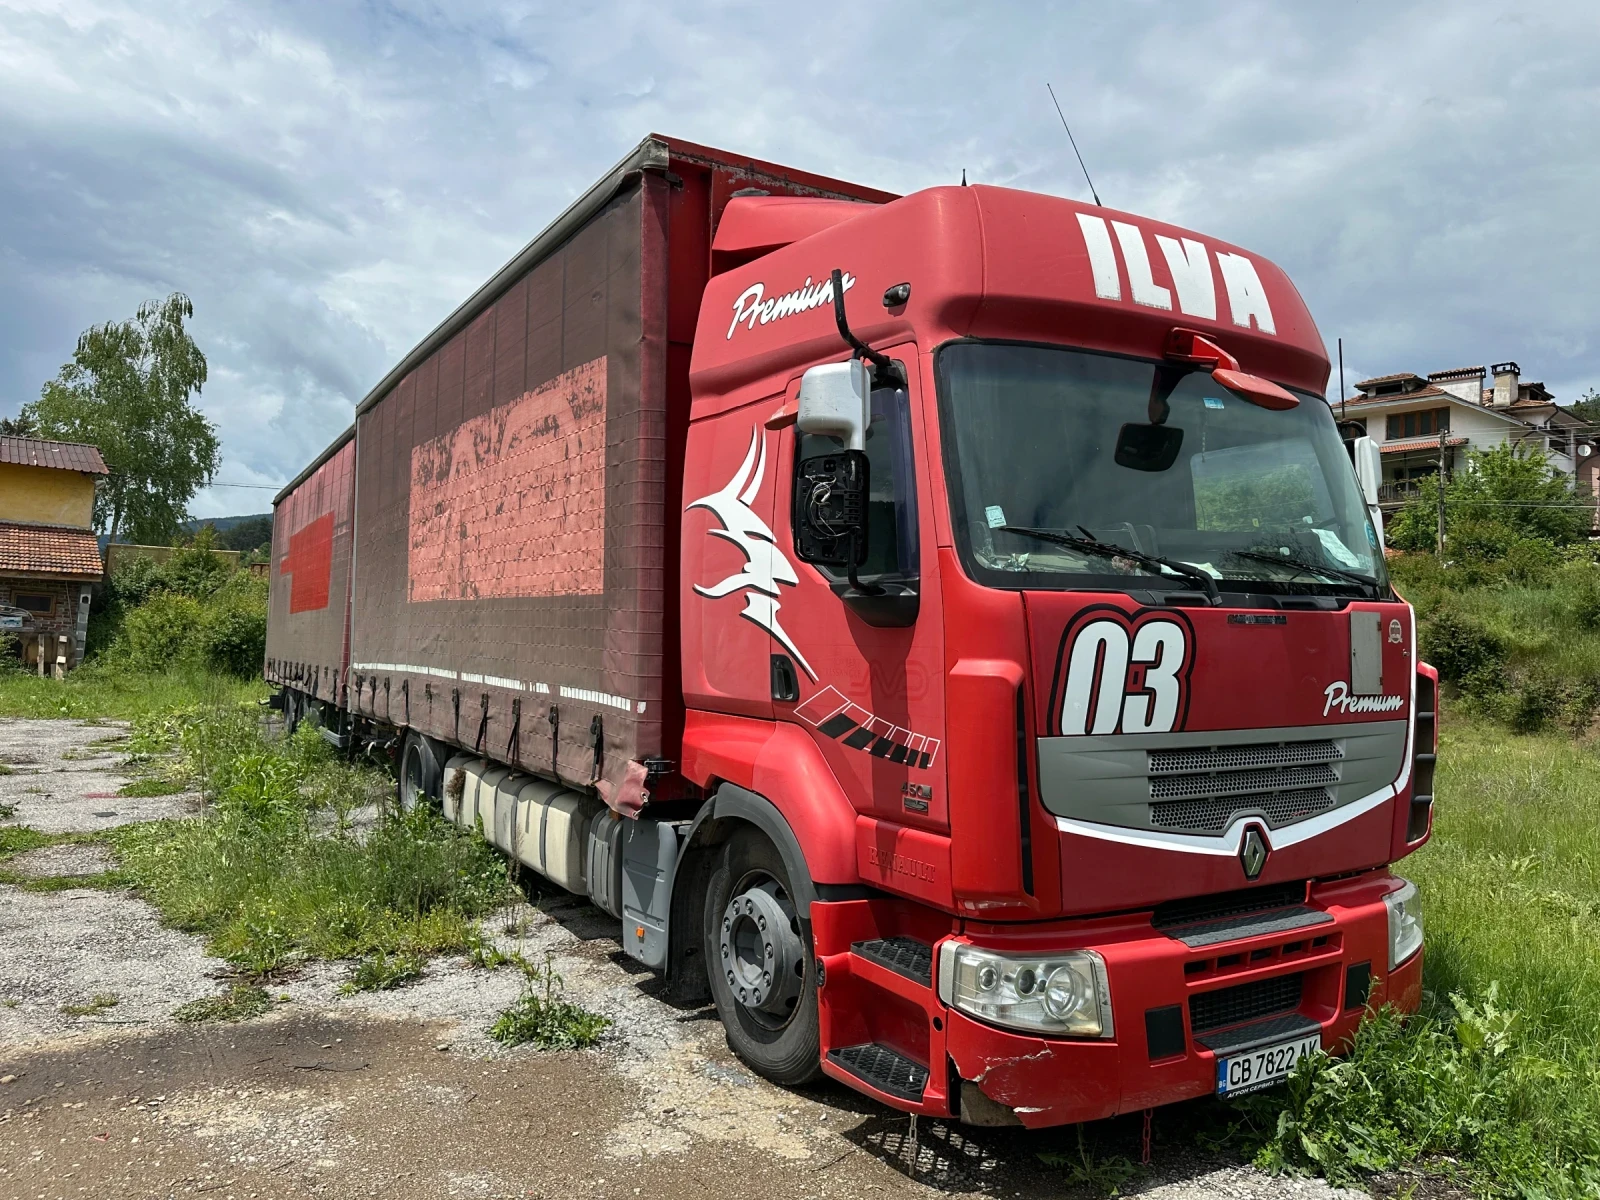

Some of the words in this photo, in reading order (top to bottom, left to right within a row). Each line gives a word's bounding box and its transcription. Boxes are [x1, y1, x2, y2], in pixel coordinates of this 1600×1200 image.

[1075, 212, 1276, 336] ILVA
[726, 271, 856, 340] Premium
[1061, 620, 1185, 735] 03
[1323, 681, 1403, 717] Premium
[1218, 1079, 1227, 1089] BG
[1230, 1058, 1252, 1086] CB
[1255, 1046, 1295, 1079] 7822
[1227, 1087, 1249, 1099] АГРОН
